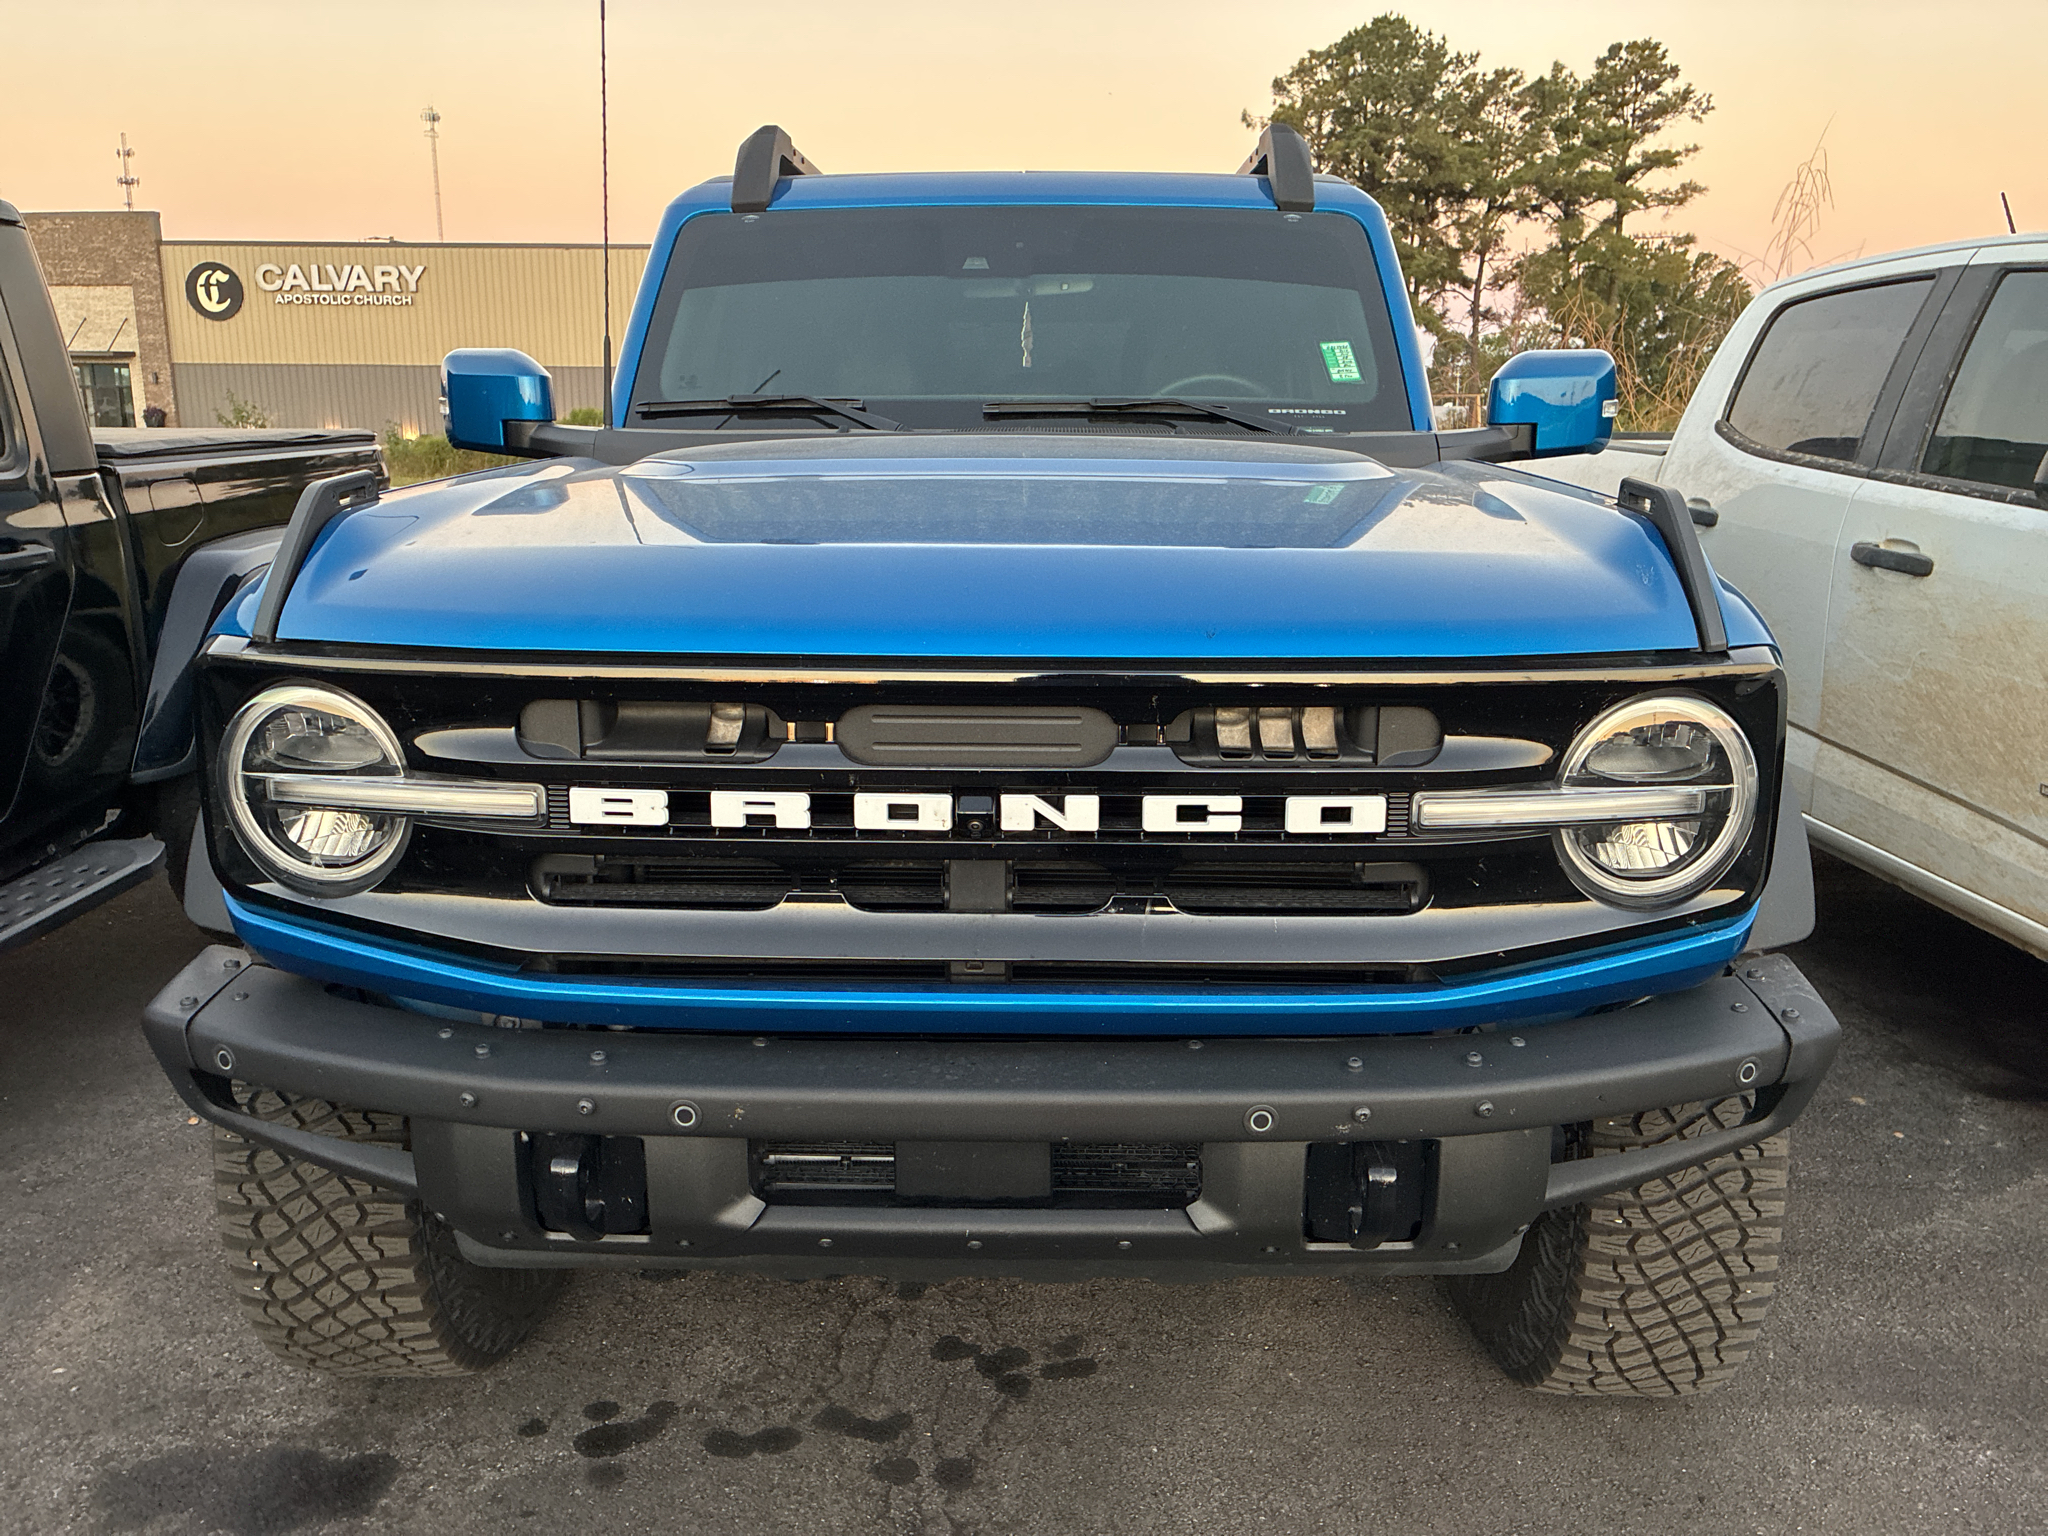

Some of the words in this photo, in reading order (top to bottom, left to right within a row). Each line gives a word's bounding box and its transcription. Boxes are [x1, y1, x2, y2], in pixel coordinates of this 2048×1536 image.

[255, 263, 426, 293] CALVARY
[275, 294, 351, 305] APOSTOLIC
[354, 294, 412, 306] CHURCH
[569, 787, 1387, 833] BRONCO
